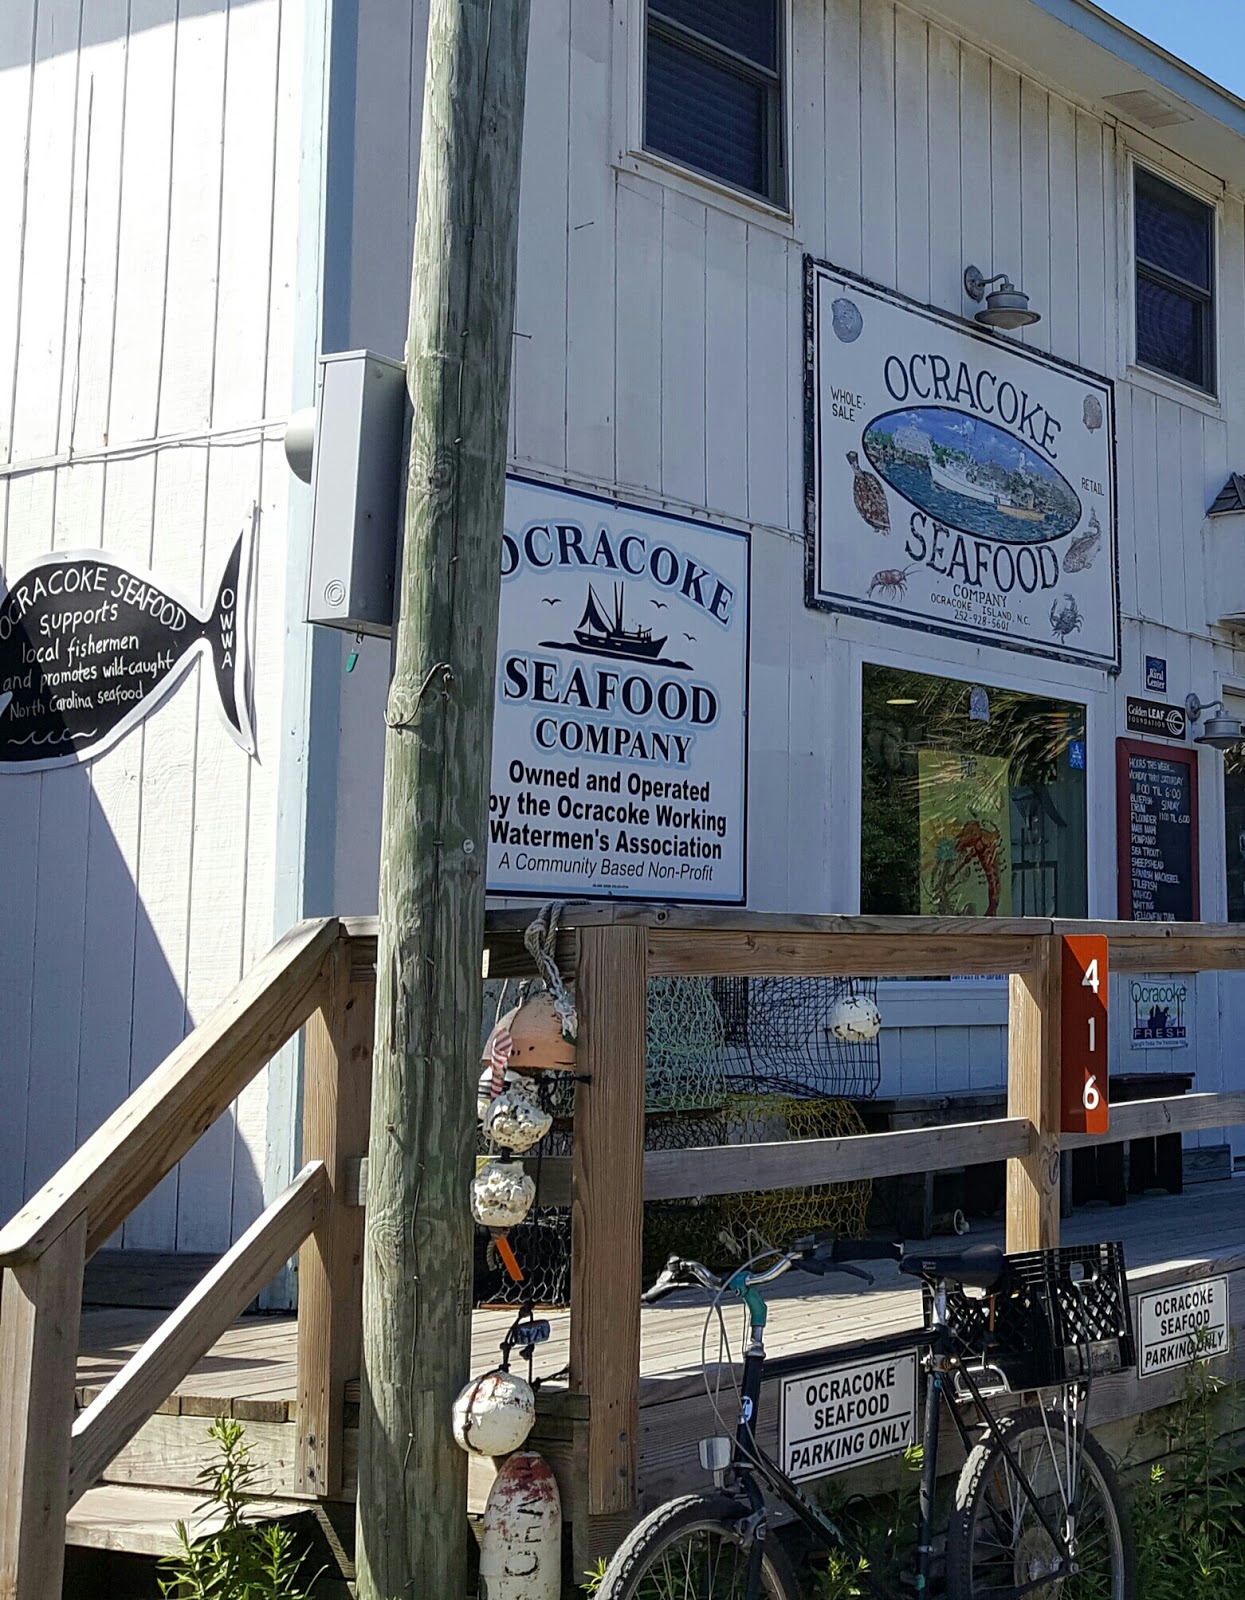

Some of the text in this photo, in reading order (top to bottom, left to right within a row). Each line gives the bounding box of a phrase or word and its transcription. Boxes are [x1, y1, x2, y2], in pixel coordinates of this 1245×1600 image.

[832, 403, 856, 422] SALE
[884, 354, 1062, 459] OCRACOKE
[1081, 477, 1105, 497] RETAIL
[905, 512, 1059, 593] SEAFOOD
[501, 525, 734, 625] OCRACOKE
[0, 567, 187, 640] OCRACOKE SEAFOOD
[930, 593, 972, 612] OCRACOKE
[953, 584, 1008, 608] COMPANY
[40, 600, 119, 637] supports
[954, 609, 1009, 631] 252-928-5601
[22, 634, 139, 666] local fishermen
[3, 649, 175, 693] and promotes wild-caught
[10, 680, 143, 721] North Carolina seafood
[503, 657, 718, 724] SEAFOOD
[1128, 704, 1165, 720] Golden LEAF
[1128, 715, 1166, 728] FOUNDATION
[535, 718, 692, 764] COMPANY
[509, 760, 710, 802] Owned and Operated
[517, 791, 550, 817] the
[557, 795, 650, 826] Ocracoke
[656, 804, 727, 837] Working
[490, 820, 722, 860] Watermen's Association
[498, 852, 714, 882] A Community Based Non-Profit
[1132, 982, 1187, 1003] Ocracoke
[1134, 1028, 1185, 1039] FRESH
[1155, 1288, 1213, 1317] OCRACOKE
[1161, 1309, 1210, 1336] SEAFOOD
[806, 1367, 895, 1406] OCRACOKE
[814, 1393, 889, 1430] SEAFOOD
[790, 1420, 911, 1471] PARKING ONLY
